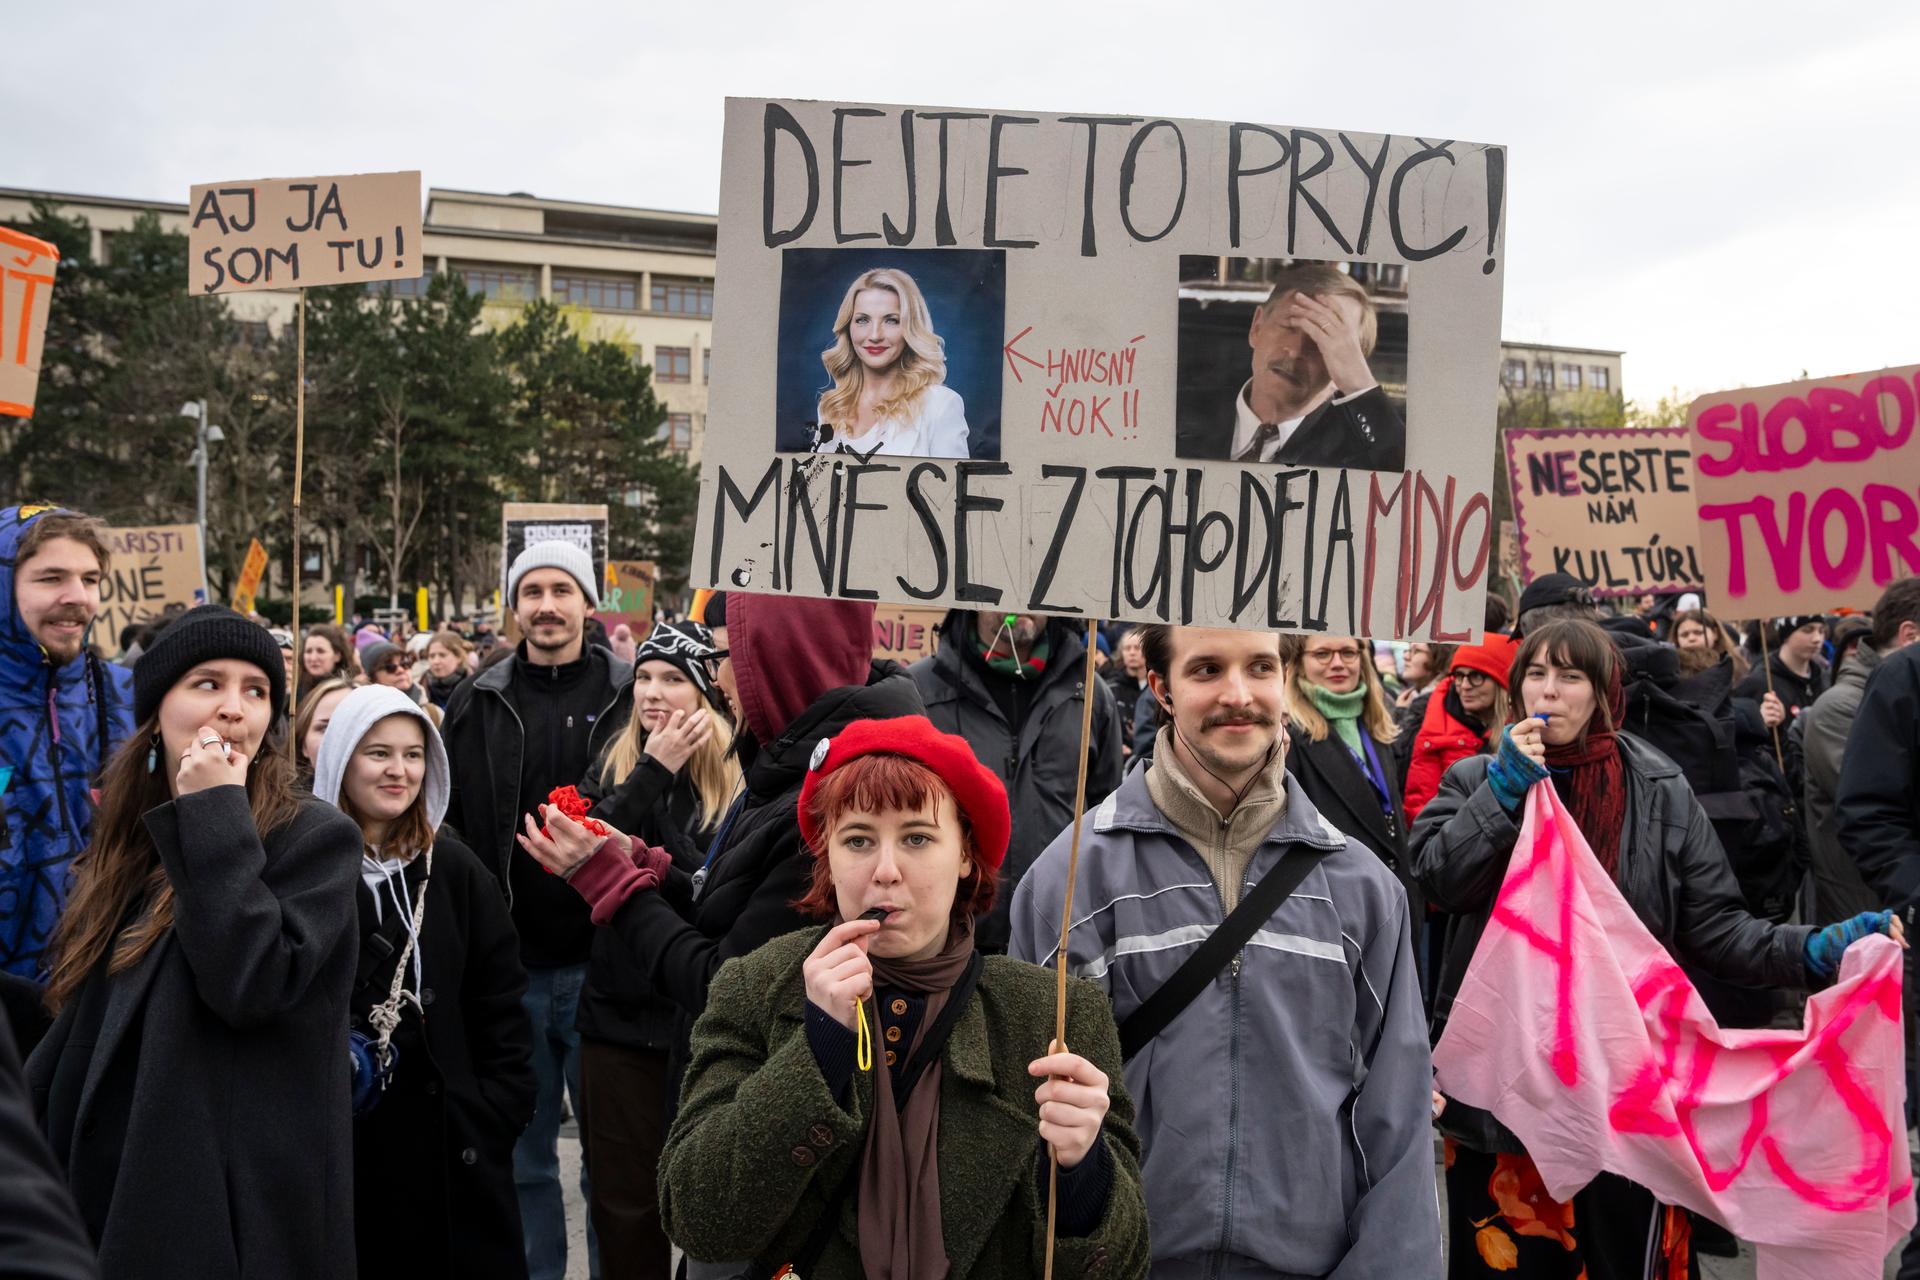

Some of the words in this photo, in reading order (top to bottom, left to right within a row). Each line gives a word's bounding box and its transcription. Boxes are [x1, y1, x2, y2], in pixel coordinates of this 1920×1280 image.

[192, 188, 256, 235] AJ
[286, 182, 348, 232] JA
[764, 103, 1040, 249] DEJTE
[1058, 116, 1187, 258] TO
[1228, 122, 1504, 275] PRYČ!
[204, 242, 299, 293] SOM
[327, 226, 404, 272] TU!
[1048, 335, 1145, 386] HNUSNÝ
[1697, 370, 1920, 477] SLOBO
[1527, 448, 1691, 496] NESERTE
[1587, 494, 1638, 524] NÁM
[98, 531, 184, 554] ARISTI
[1361, 469, 1491, 642] MDLO
[1697, 483, 1920, 597] TVOR
